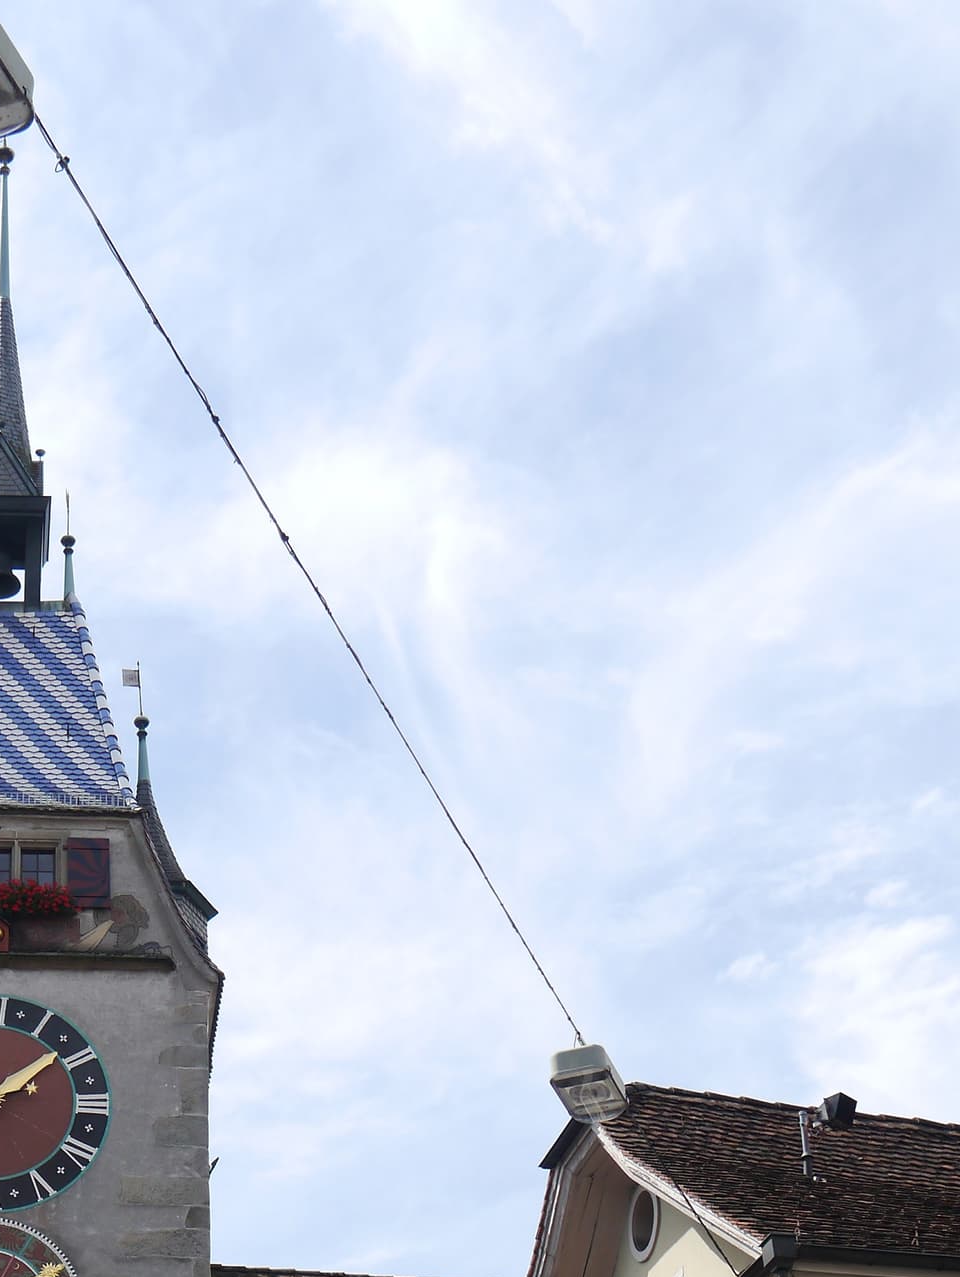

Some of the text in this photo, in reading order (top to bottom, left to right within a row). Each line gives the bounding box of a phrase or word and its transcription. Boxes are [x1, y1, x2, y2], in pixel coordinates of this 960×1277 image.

[31, 1010, 54, 1038] I
[62, 1045, 97, 1071] II
[76, 1092, 109, 1115] III
[60, 1135, 99, 1171] IV
[29, 1169, 57, 1201] V
